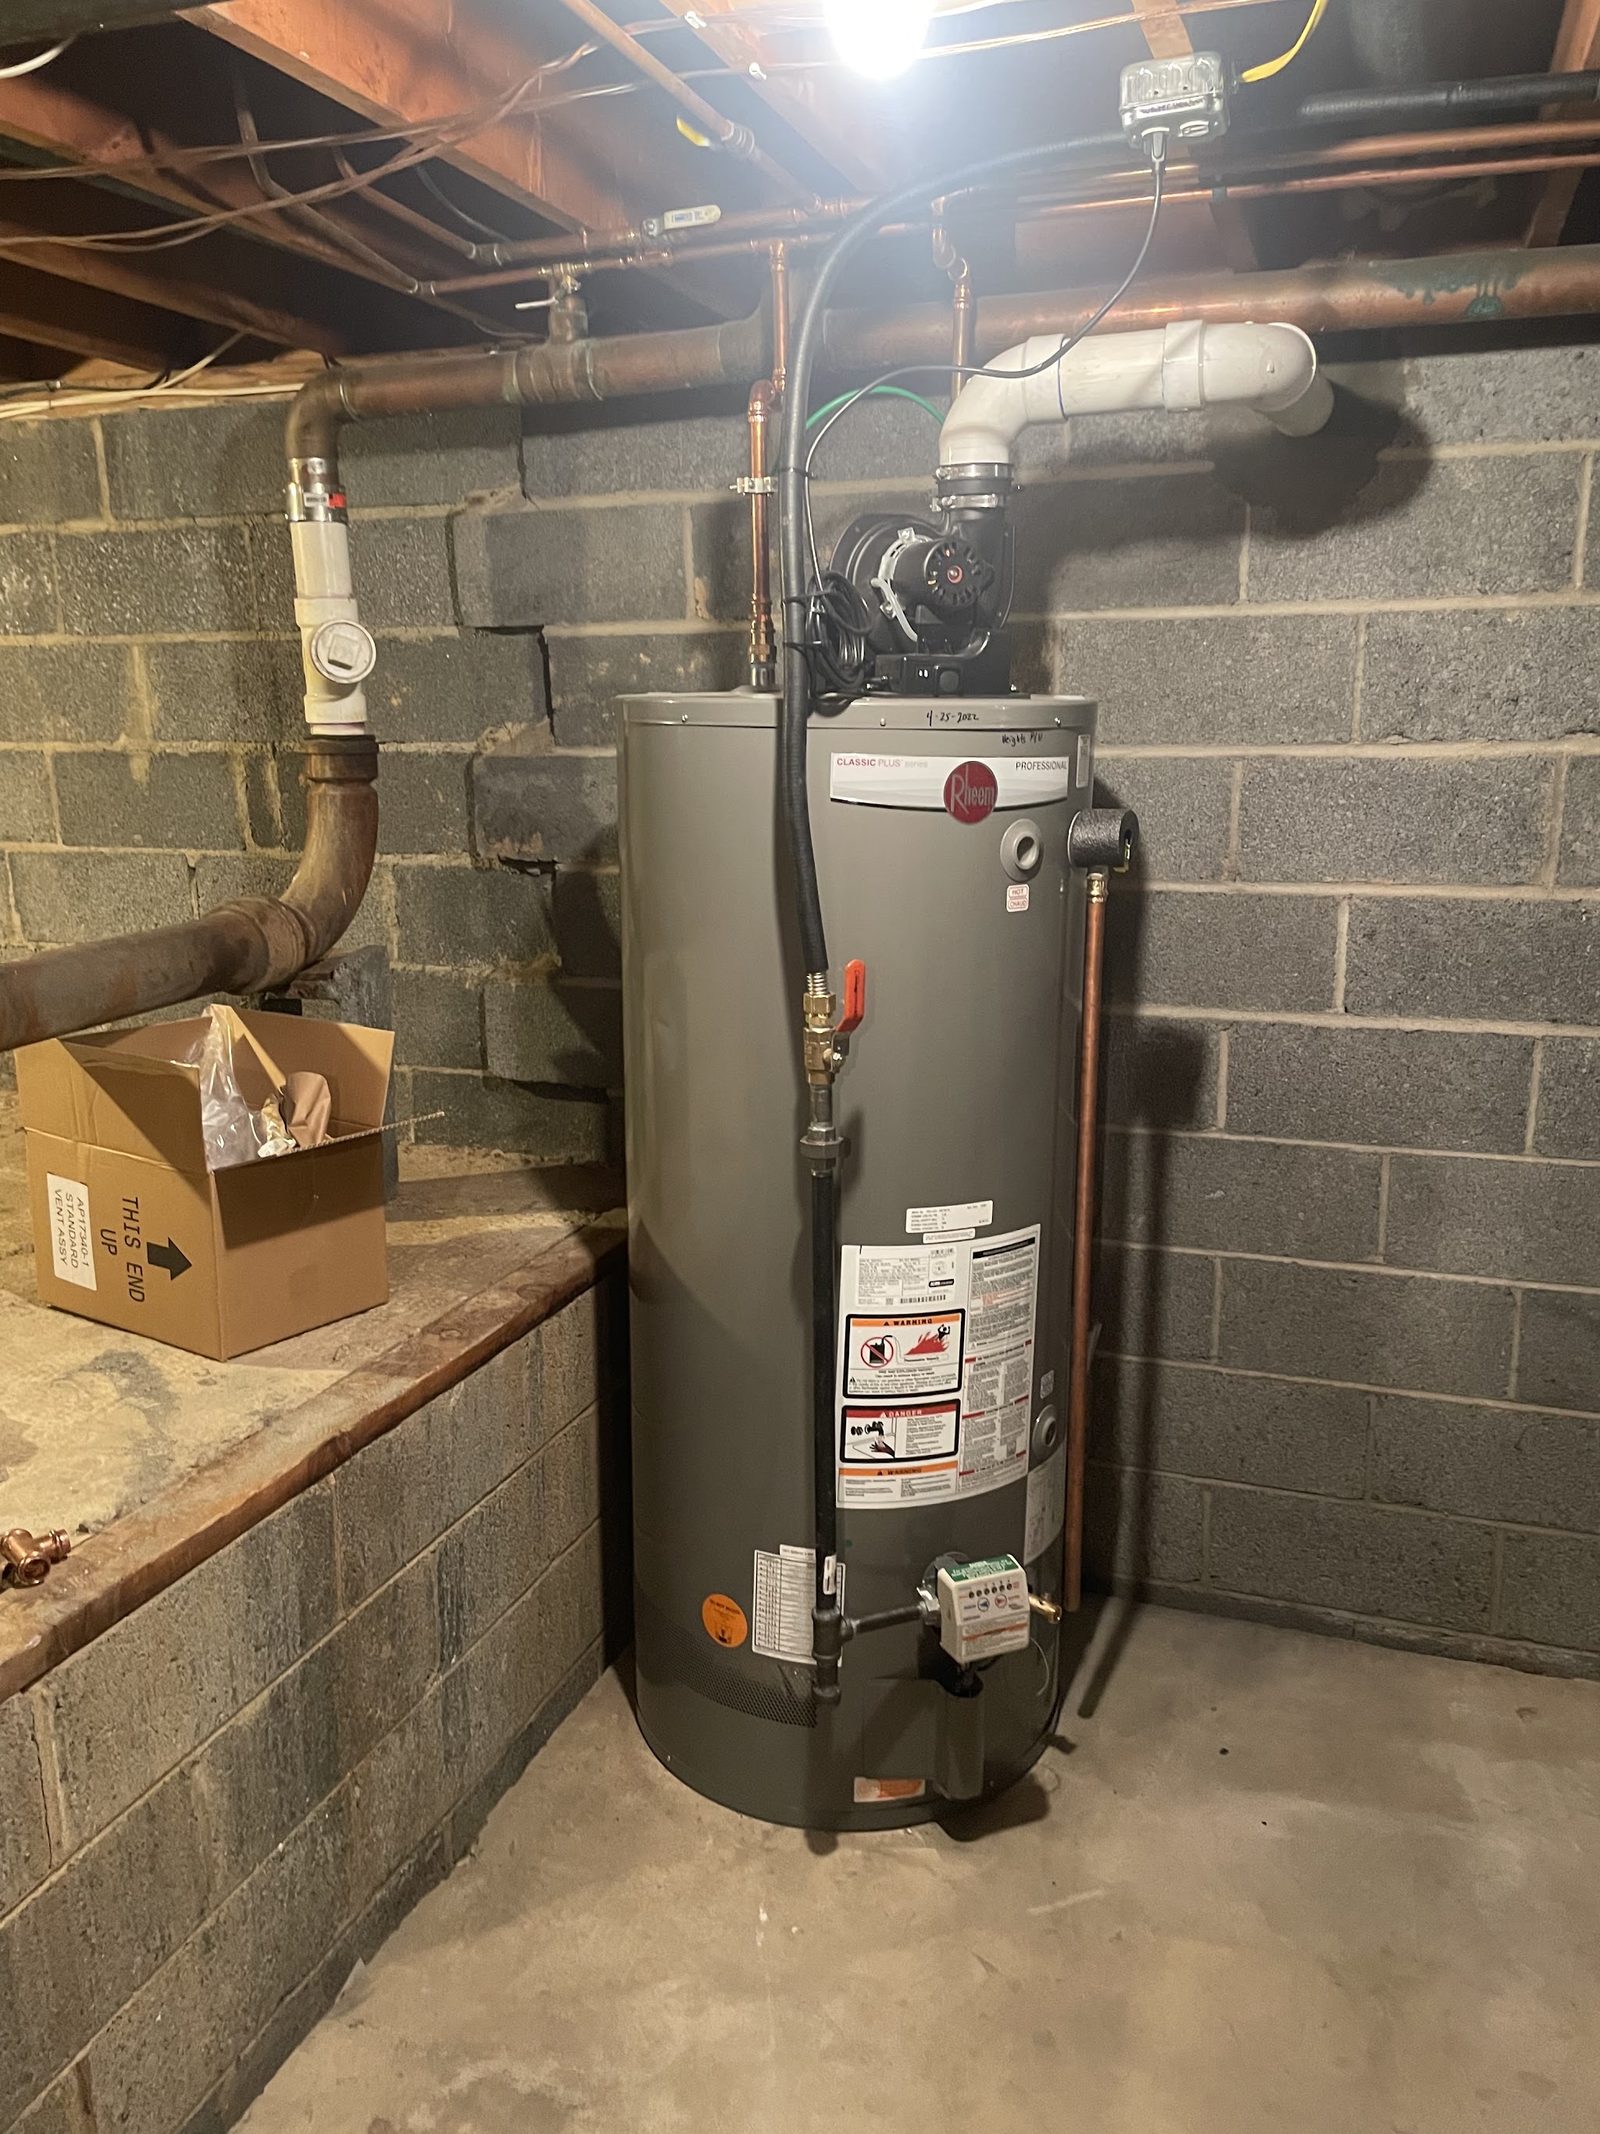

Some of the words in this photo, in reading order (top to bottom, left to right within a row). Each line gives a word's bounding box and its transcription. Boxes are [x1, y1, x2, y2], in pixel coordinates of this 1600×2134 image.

[836, 758, 877, 767] CLASSIC
[878, 759, 901, 768] PLUS
[1015, 761, 1068, 771] PROFESSIONAL
[950, 764, 995, 815] Rheem
[54, 1189, 65, 1227] VENT
[122, 1196, 141, 1249] THIS
[57, 1227, 68, 1266] ASSY
[65, 1193, 79, 1269] STANDARD
[77, 1196, 90, 1267] AP17340-1
[100, 1228, 118, 1256] UP
[126, 1262, 145, 1303] END
[893, 1318, 933, 1326] WARNING
